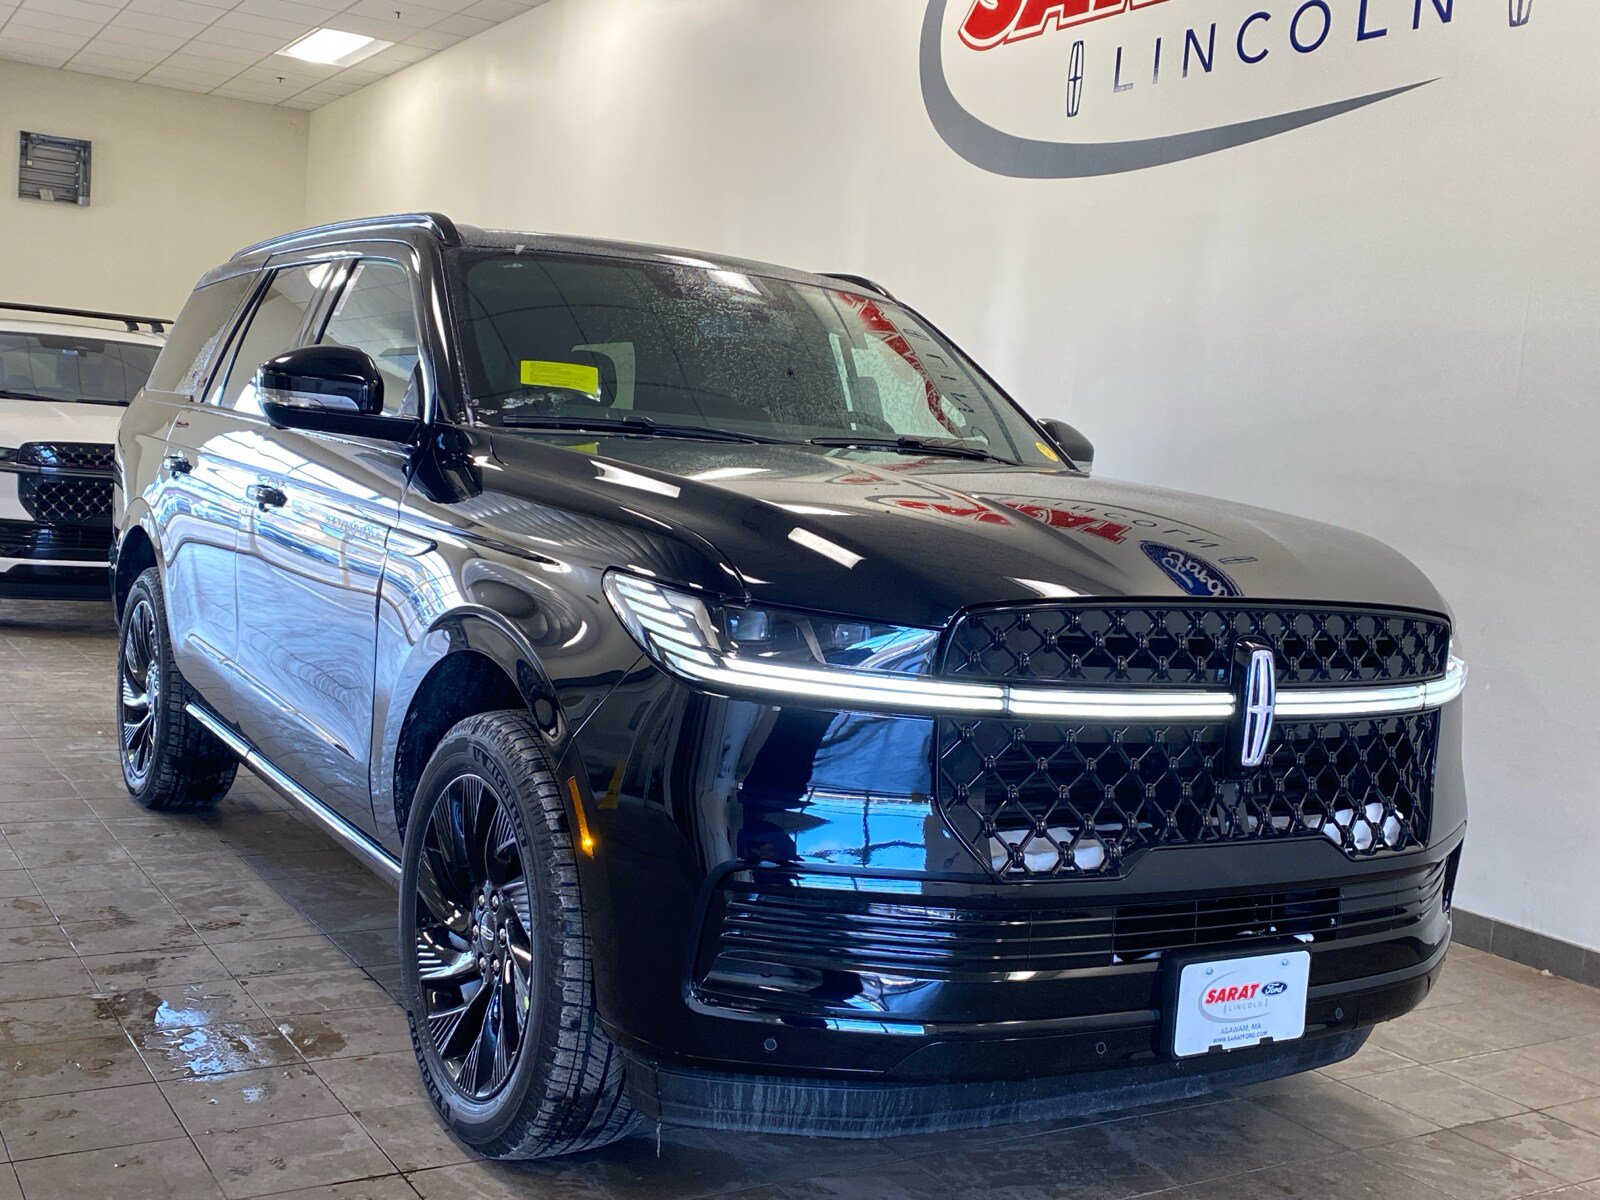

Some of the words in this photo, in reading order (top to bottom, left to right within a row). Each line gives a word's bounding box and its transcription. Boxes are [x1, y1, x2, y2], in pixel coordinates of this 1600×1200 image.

[1112, 0, 1453, 93] LINCOLN
[1205, 983, 1260, 1005] SARAT
[1263, 982, 1286, 996] Ford
[1228, 1000, 1263, 1012] LINCOLN
[1251, 1023, 1262, 1031] MA
[1212, 1030, 1268, 1044] WWW.SARATFORD.COM
